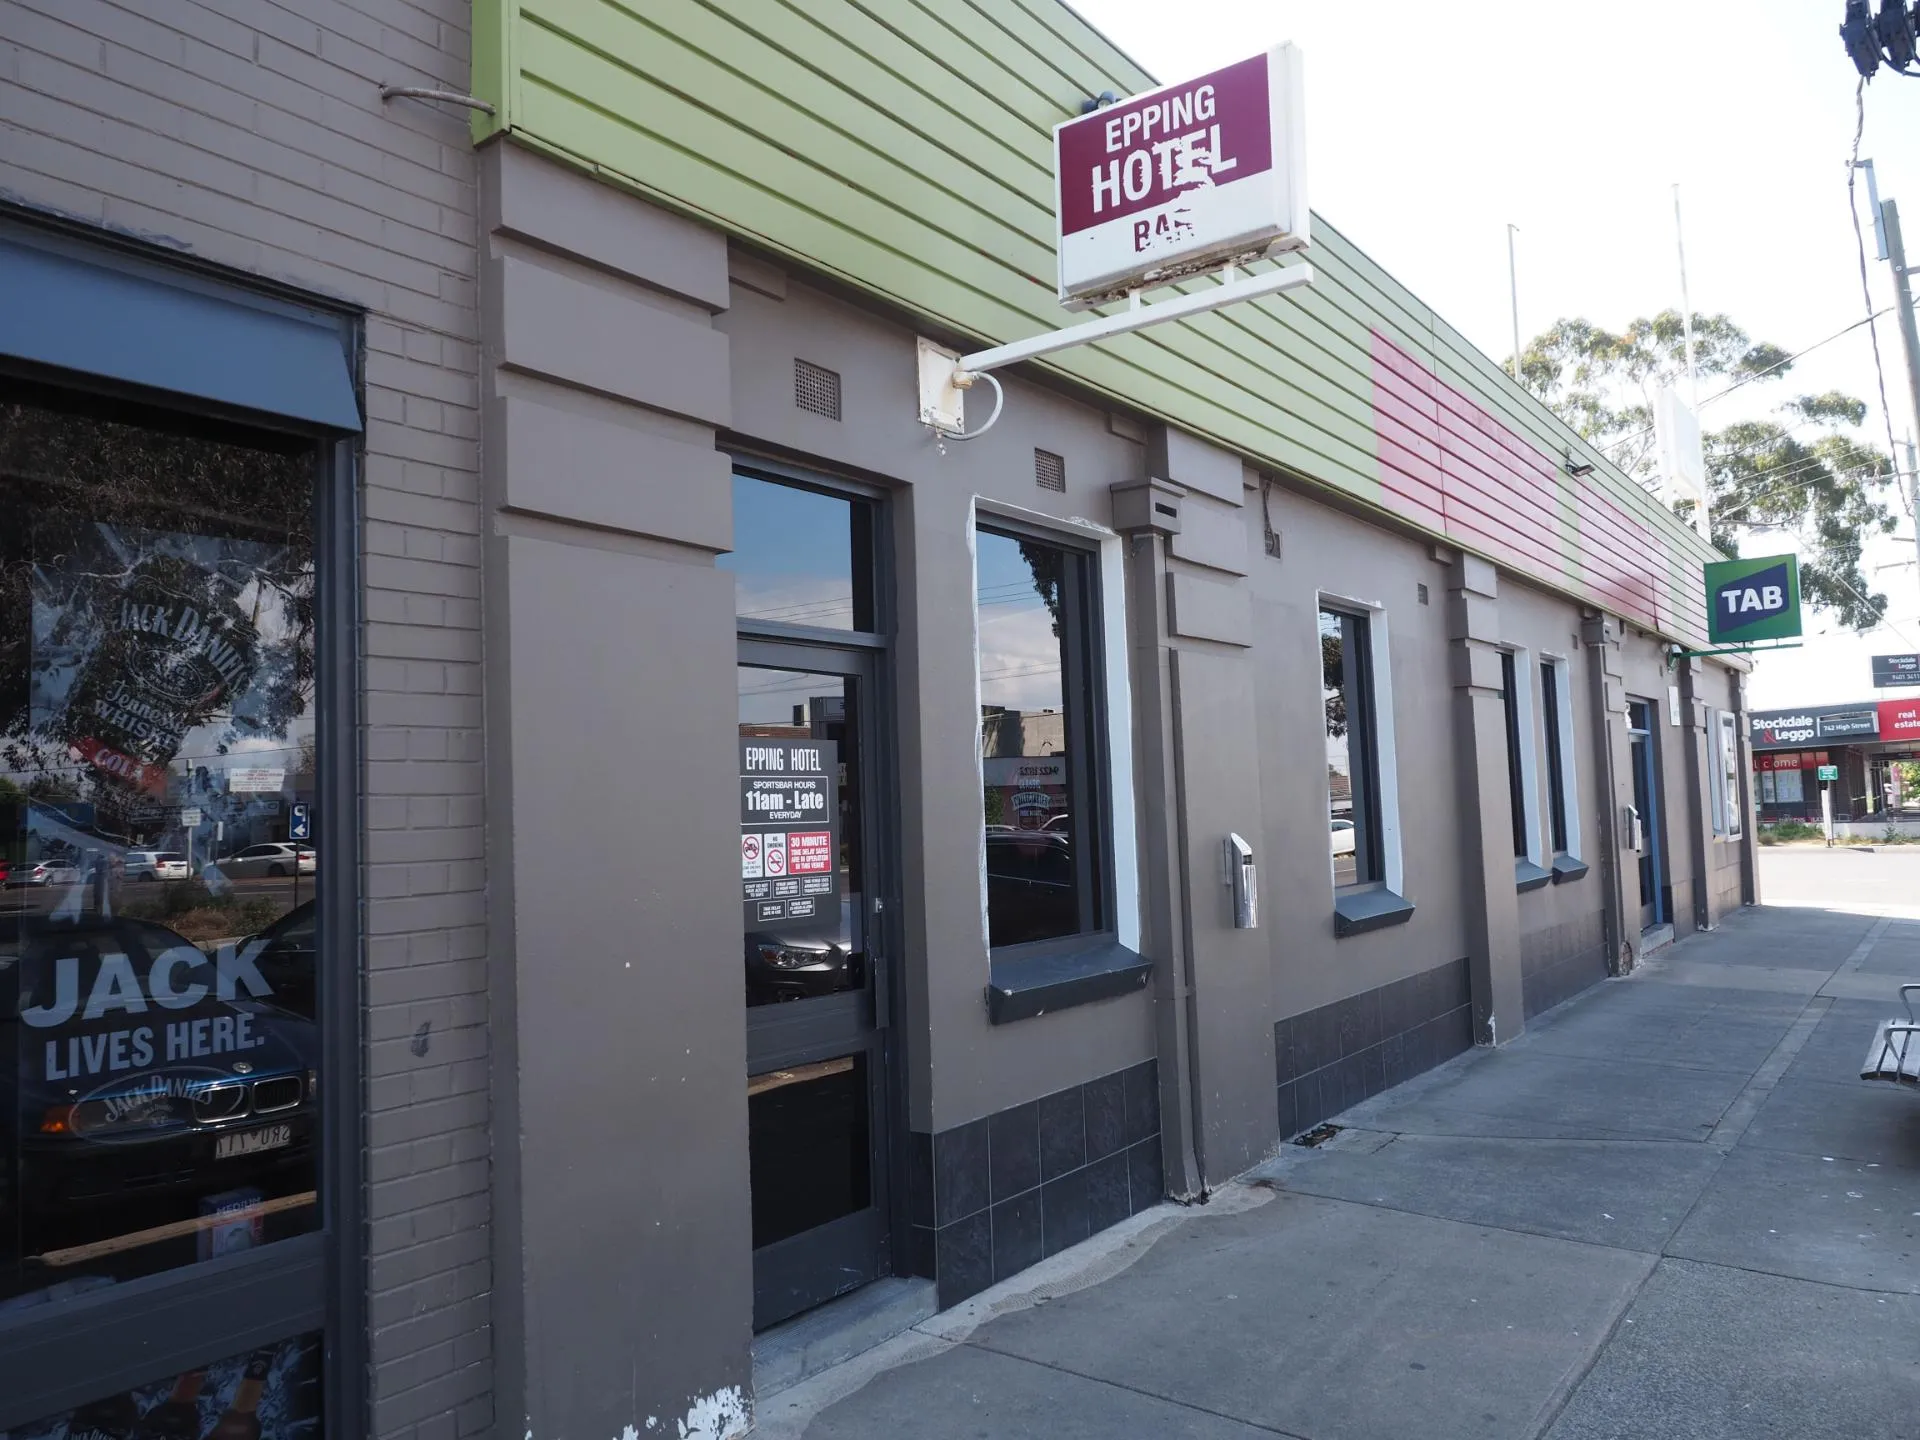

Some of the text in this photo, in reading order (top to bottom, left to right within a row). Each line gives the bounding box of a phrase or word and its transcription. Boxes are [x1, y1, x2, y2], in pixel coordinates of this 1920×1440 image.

[1106, 85, 1216, 154] EPPING
[1091, 124, 1237, 214] HOTEL
[1133, 207, 1195, 253] BA
[1721, 585, 1783, 614] TAB
[1752, 715, 1813, 730] Stockdale
[1898, 709, 1916, 719] real
[1775, 728, 1814, 742] Leggo
[1836, 723, 1851, 733] High
[1851, 721, 1871, 730] Street
[746, 747, 821, 771] EPPING HOTEL
[753, 781, 816, 789] SPORTSBAR HOURS
[745, 790, 784, 810] 11am
[794, 790, 824, 809] Late
[769, 811, 802, 819] EVERYDAY
[790, 837, 800, 847] 30
[21, 938, 275, 1028] JACK
[46, 1011, 265, 1081] LIVES HERE.
[104, 1084, 149, 1122] JACK
